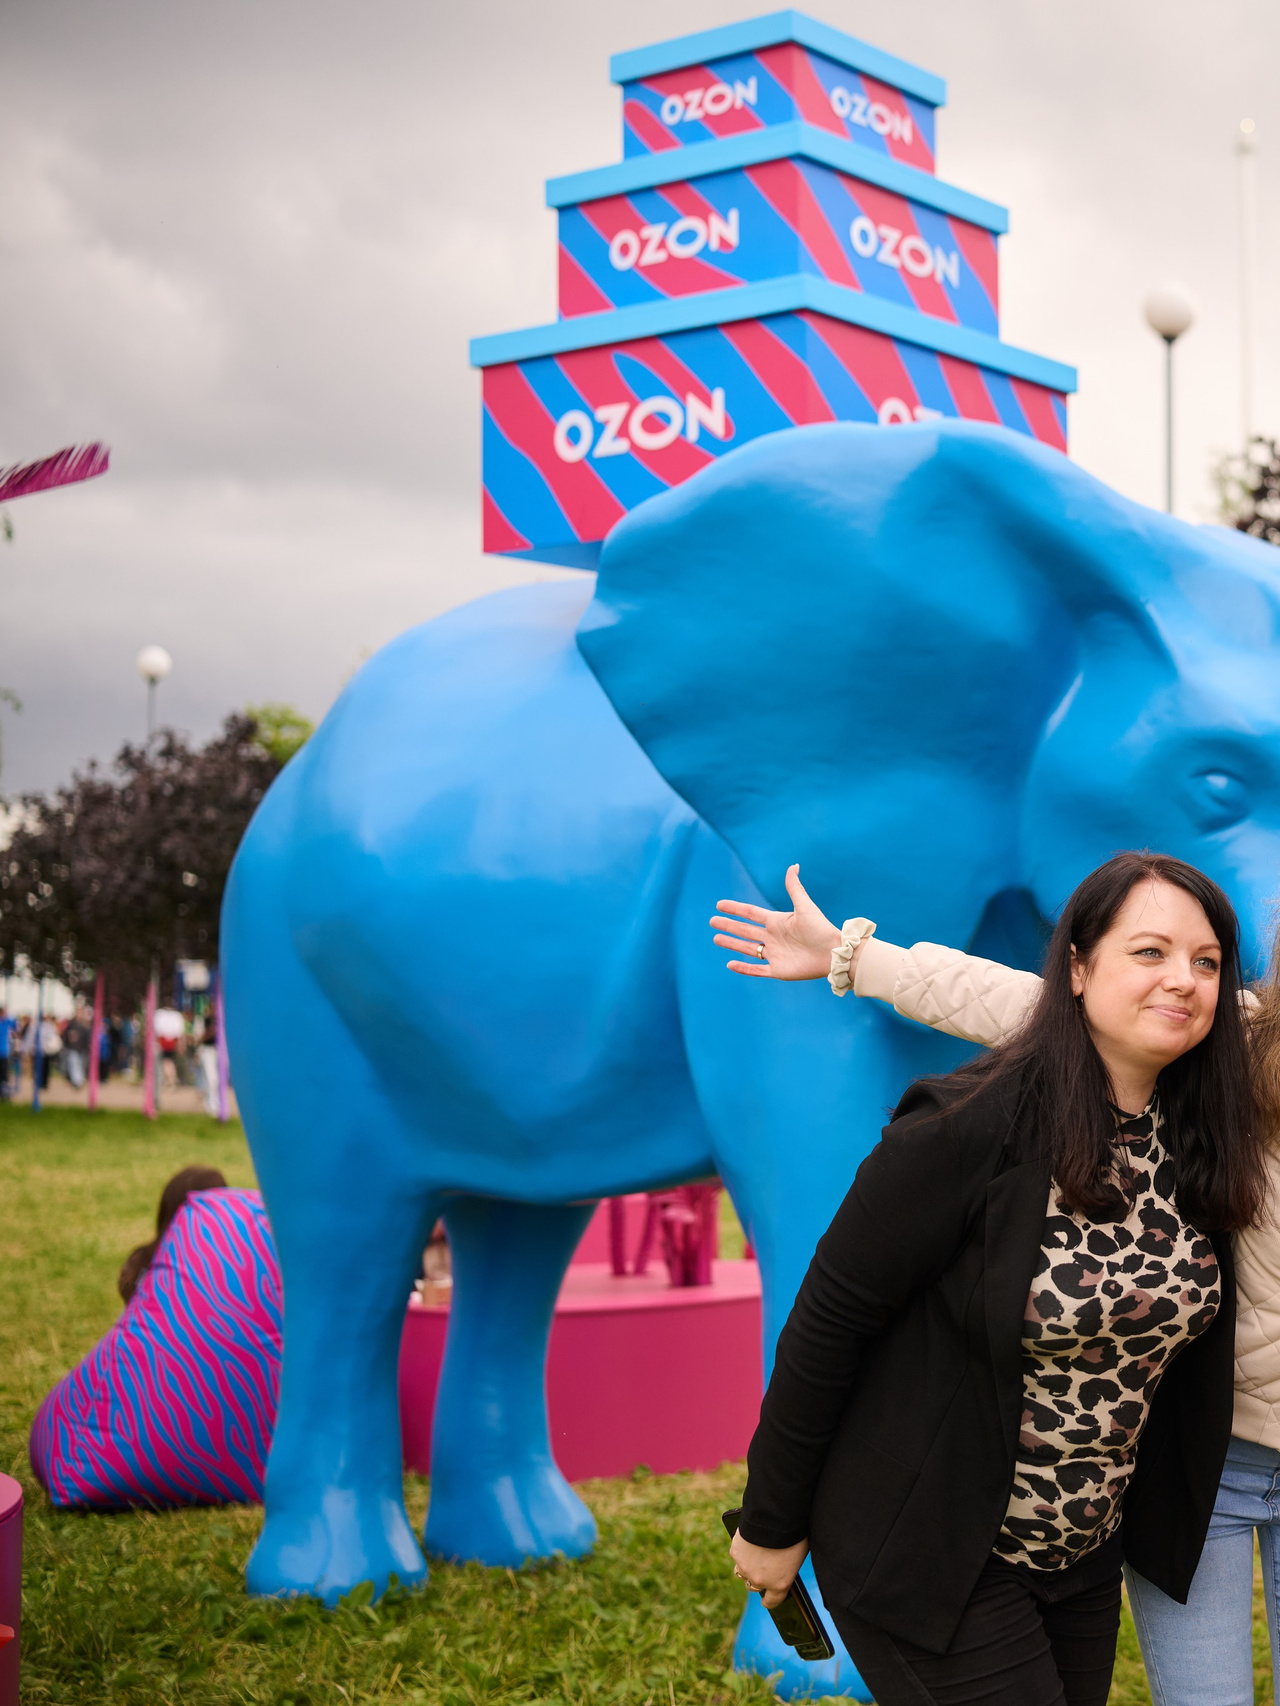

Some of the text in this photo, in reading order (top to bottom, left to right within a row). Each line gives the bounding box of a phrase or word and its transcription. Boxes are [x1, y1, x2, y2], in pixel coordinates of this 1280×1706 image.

[660, 76, 757, 126] OZON
[830, 86, 913, 145] OZON
[609, 207, 739, 271] OZON
[850, 215, 960, 289] OZON
[553, 386, 725, 463] OZON
